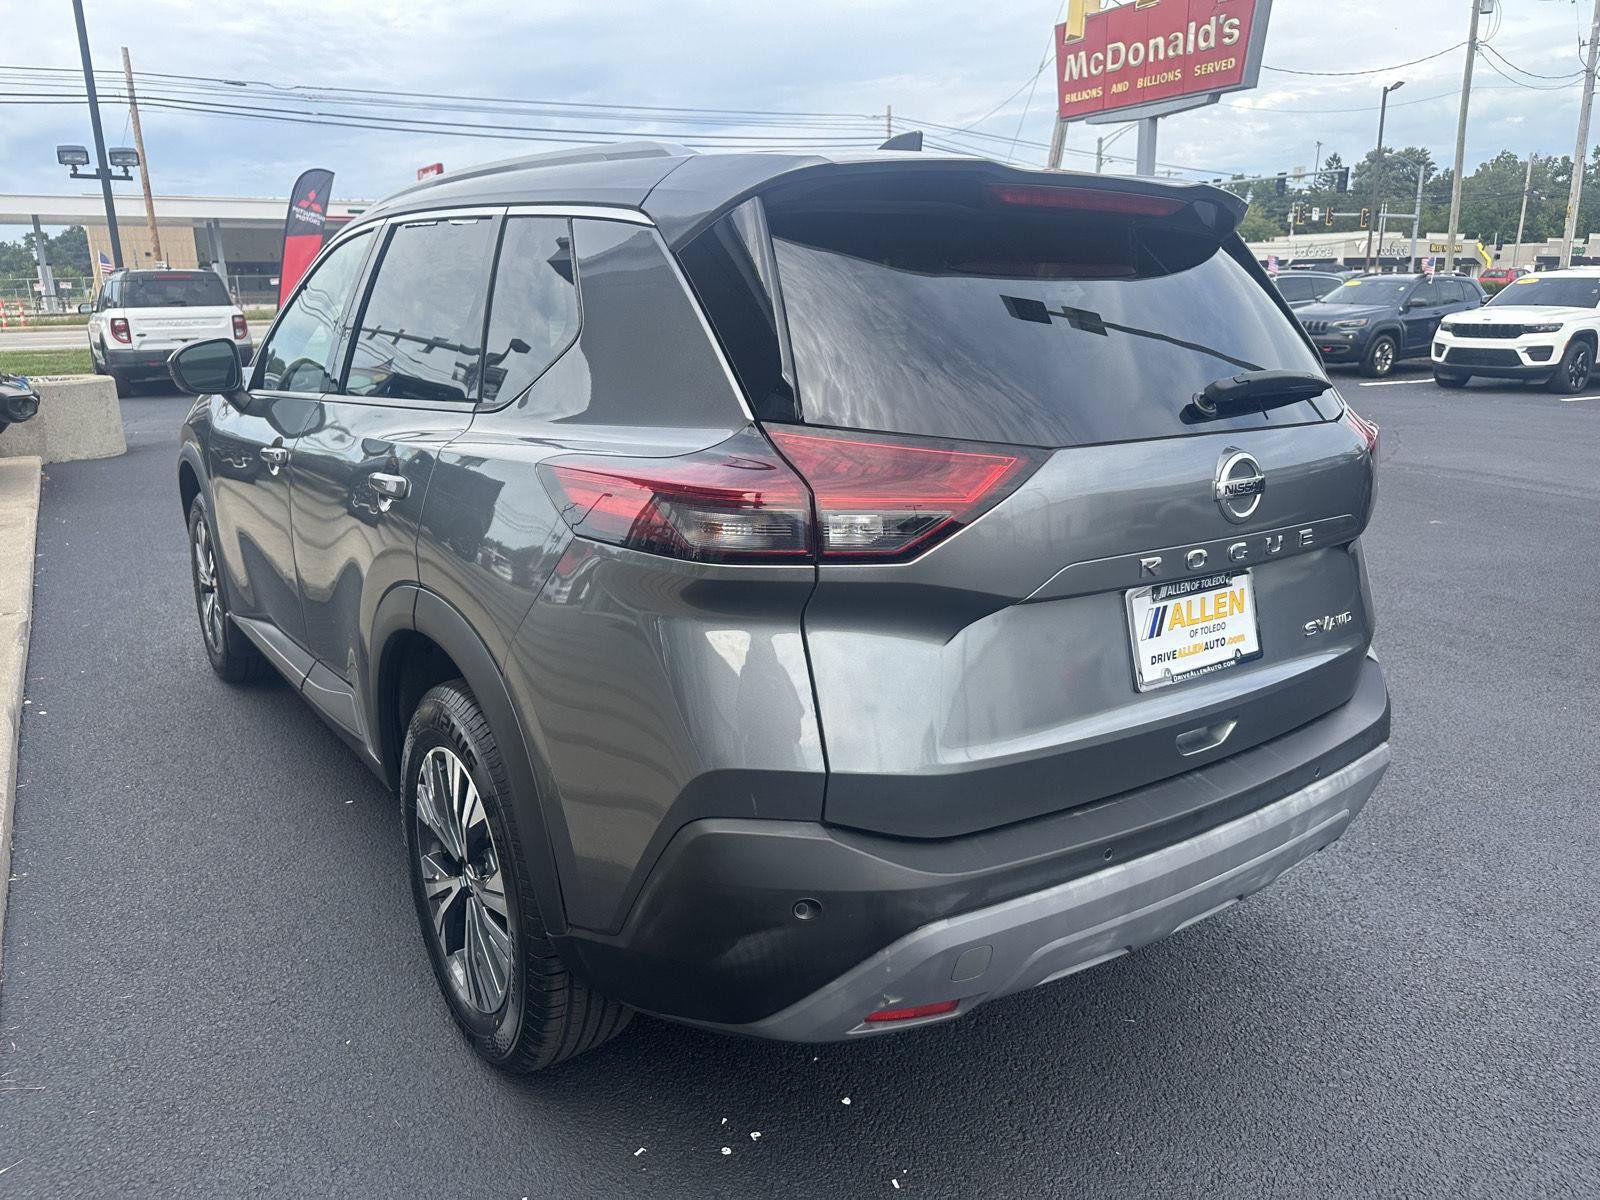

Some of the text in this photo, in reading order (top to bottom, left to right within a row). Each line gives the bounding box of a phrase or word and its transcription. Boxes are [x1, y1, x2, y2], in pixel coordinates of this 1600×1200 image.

[1063, 14, 1242, 83] McDonald's
[1065, 57, 1236, 104] BILLIONS AND BILLIONS SERVED
[295, 213, 321, 226] MOTORS
[1294, 241, 1334, 258] balance
[1224, 479, 1266, 497] NISSAN
[1137, 528, 1315, 579] ROGUE
[1166, 575, 1226, 597] ALLEN OF TOLEDO
[1168, 588, 1245, 632] ALLEN
[1189, 622, 1227, 639] OF TOLEDO
